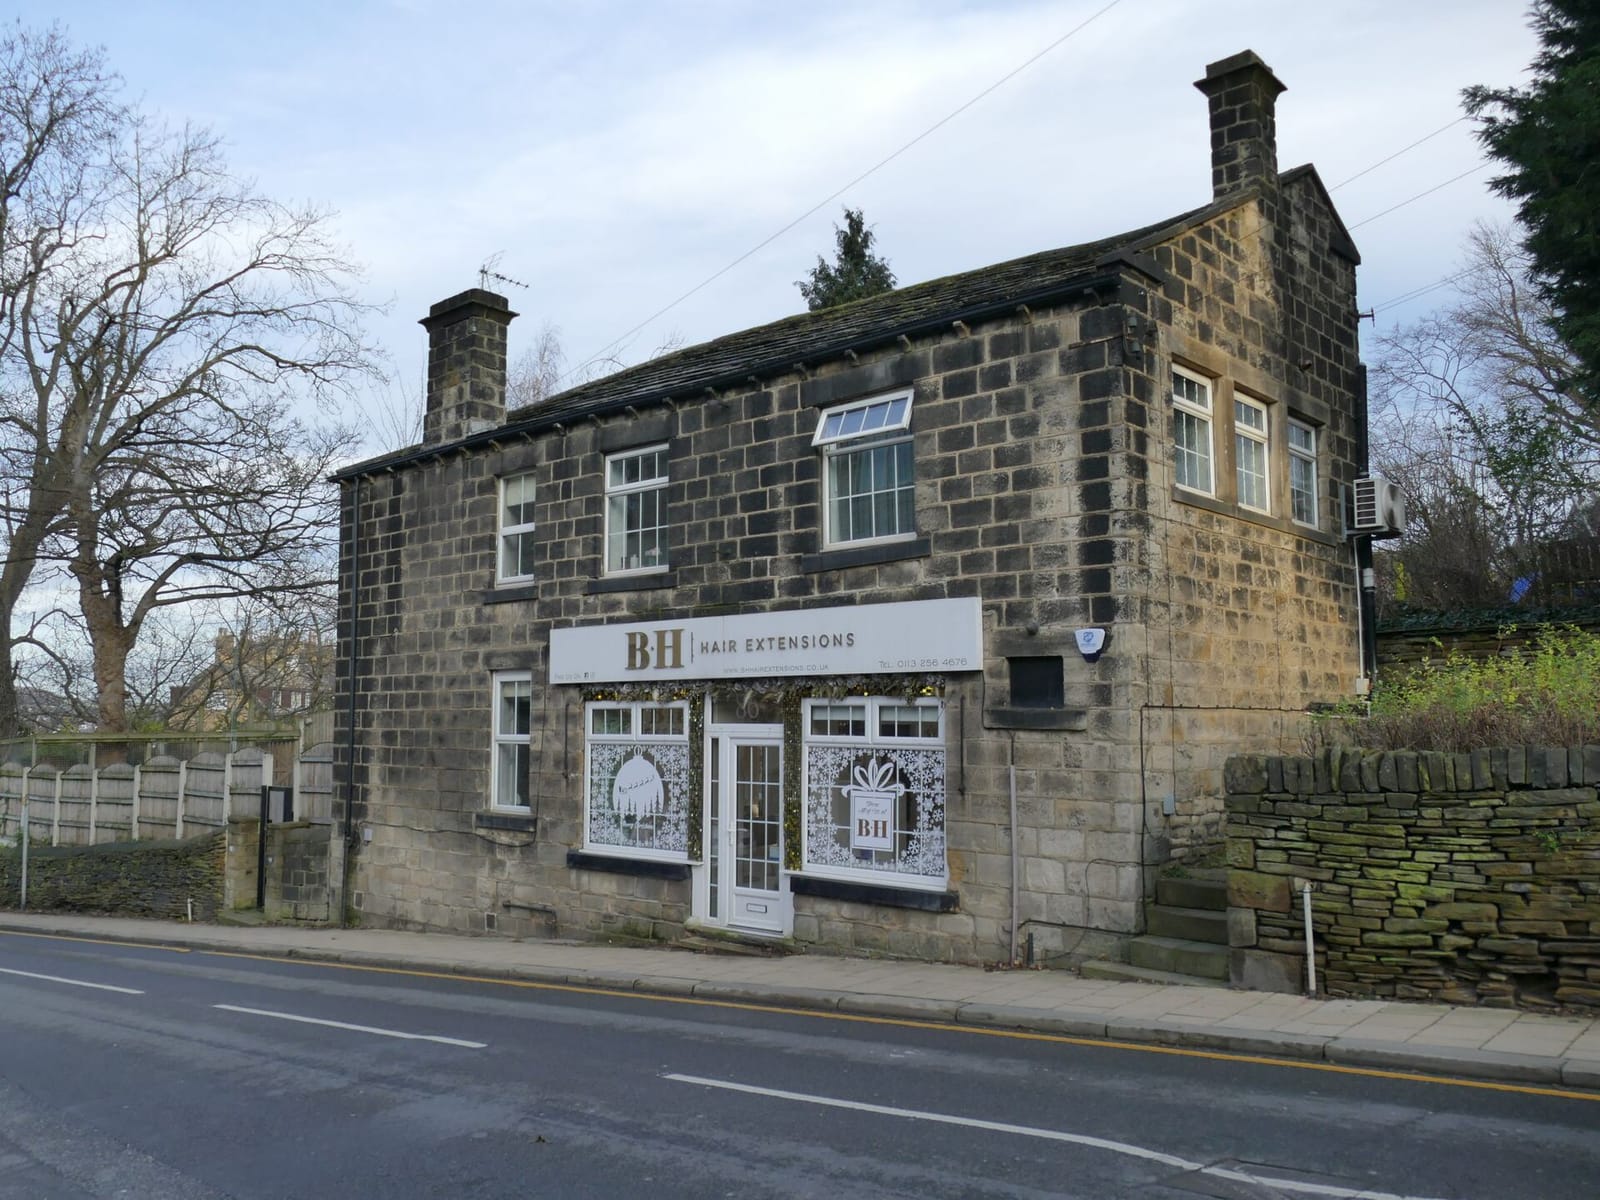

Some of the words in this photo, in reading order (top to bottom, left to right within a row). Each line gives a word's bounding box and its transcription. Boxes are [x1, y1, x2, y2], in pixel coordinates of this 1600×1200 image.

[700, 639, 737, 654] HAIR
[745, 632, 855, 652] EXTENSIONS
[897, 659, 917, 668] 0113
